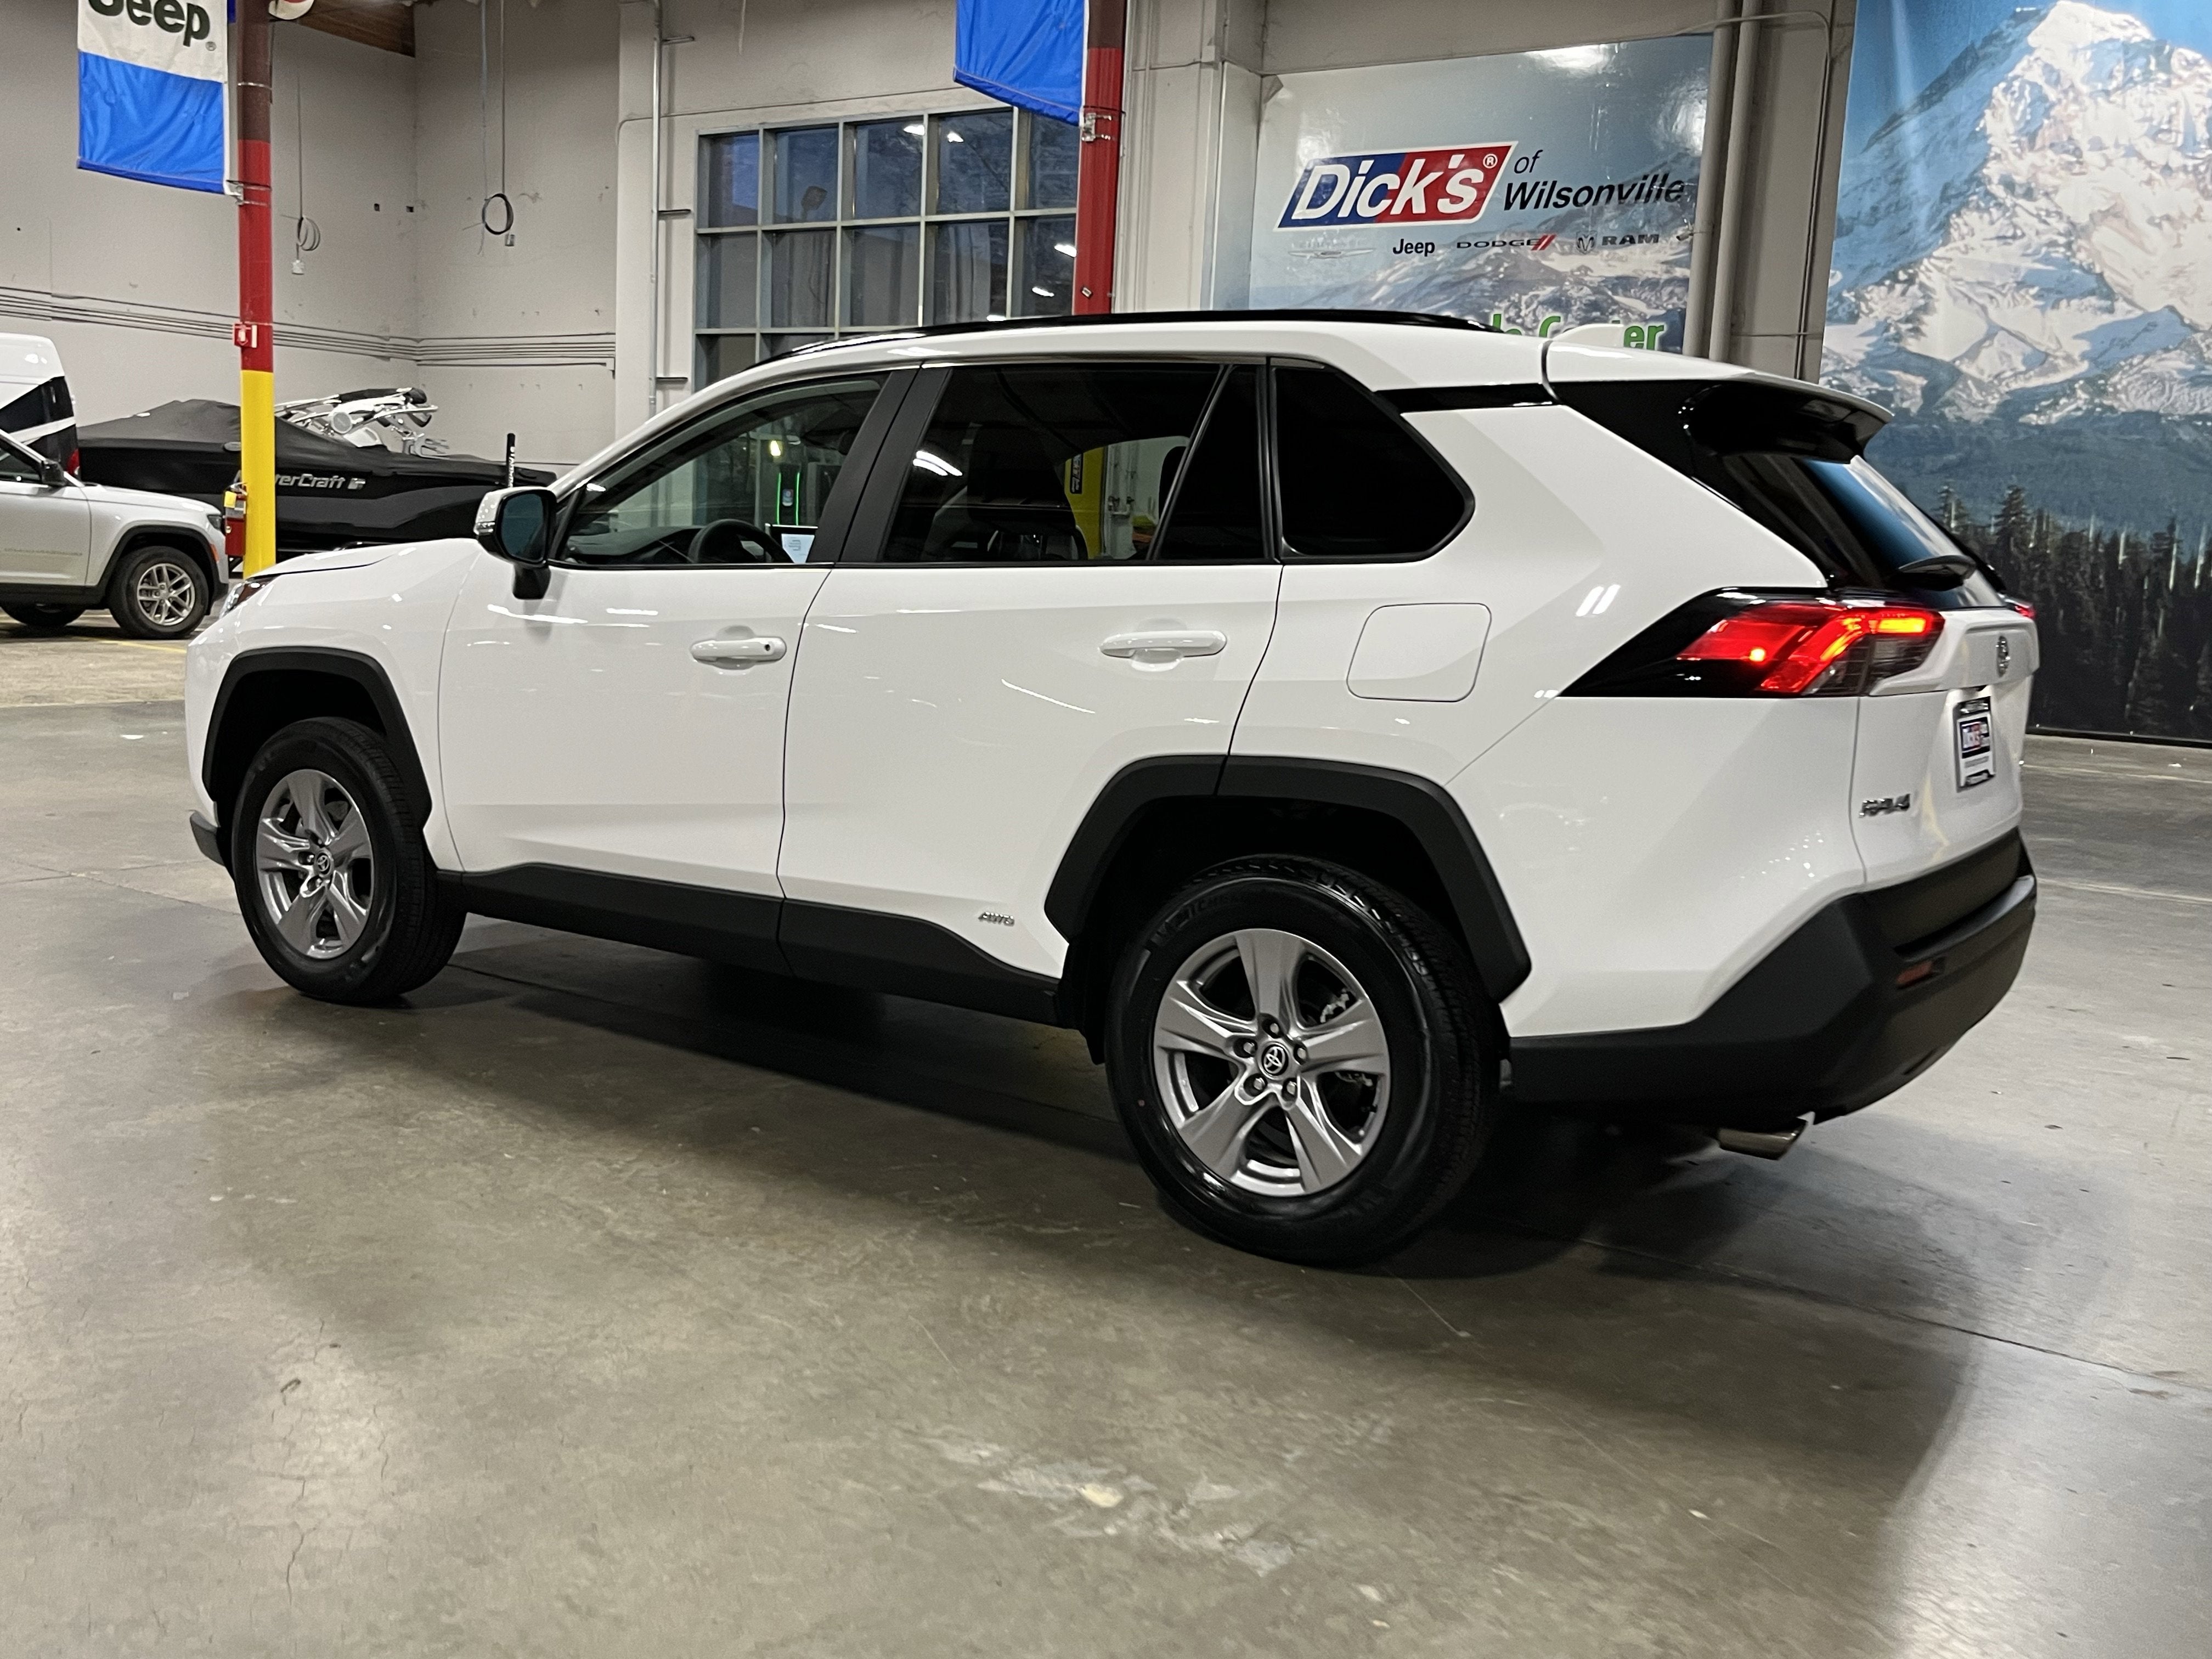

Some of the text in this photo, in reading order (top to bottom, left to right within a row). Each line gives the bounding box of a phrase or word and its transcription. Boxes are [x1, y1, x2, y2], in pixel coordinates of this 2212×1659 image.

[1514, 149, 1543, 174] of
[1291, 154, 1484, 219] Dick's
[1504, 173, 1686, 211] Wilsonville
[1392, 234, 1660, 257] Jeep DODGE RAM
